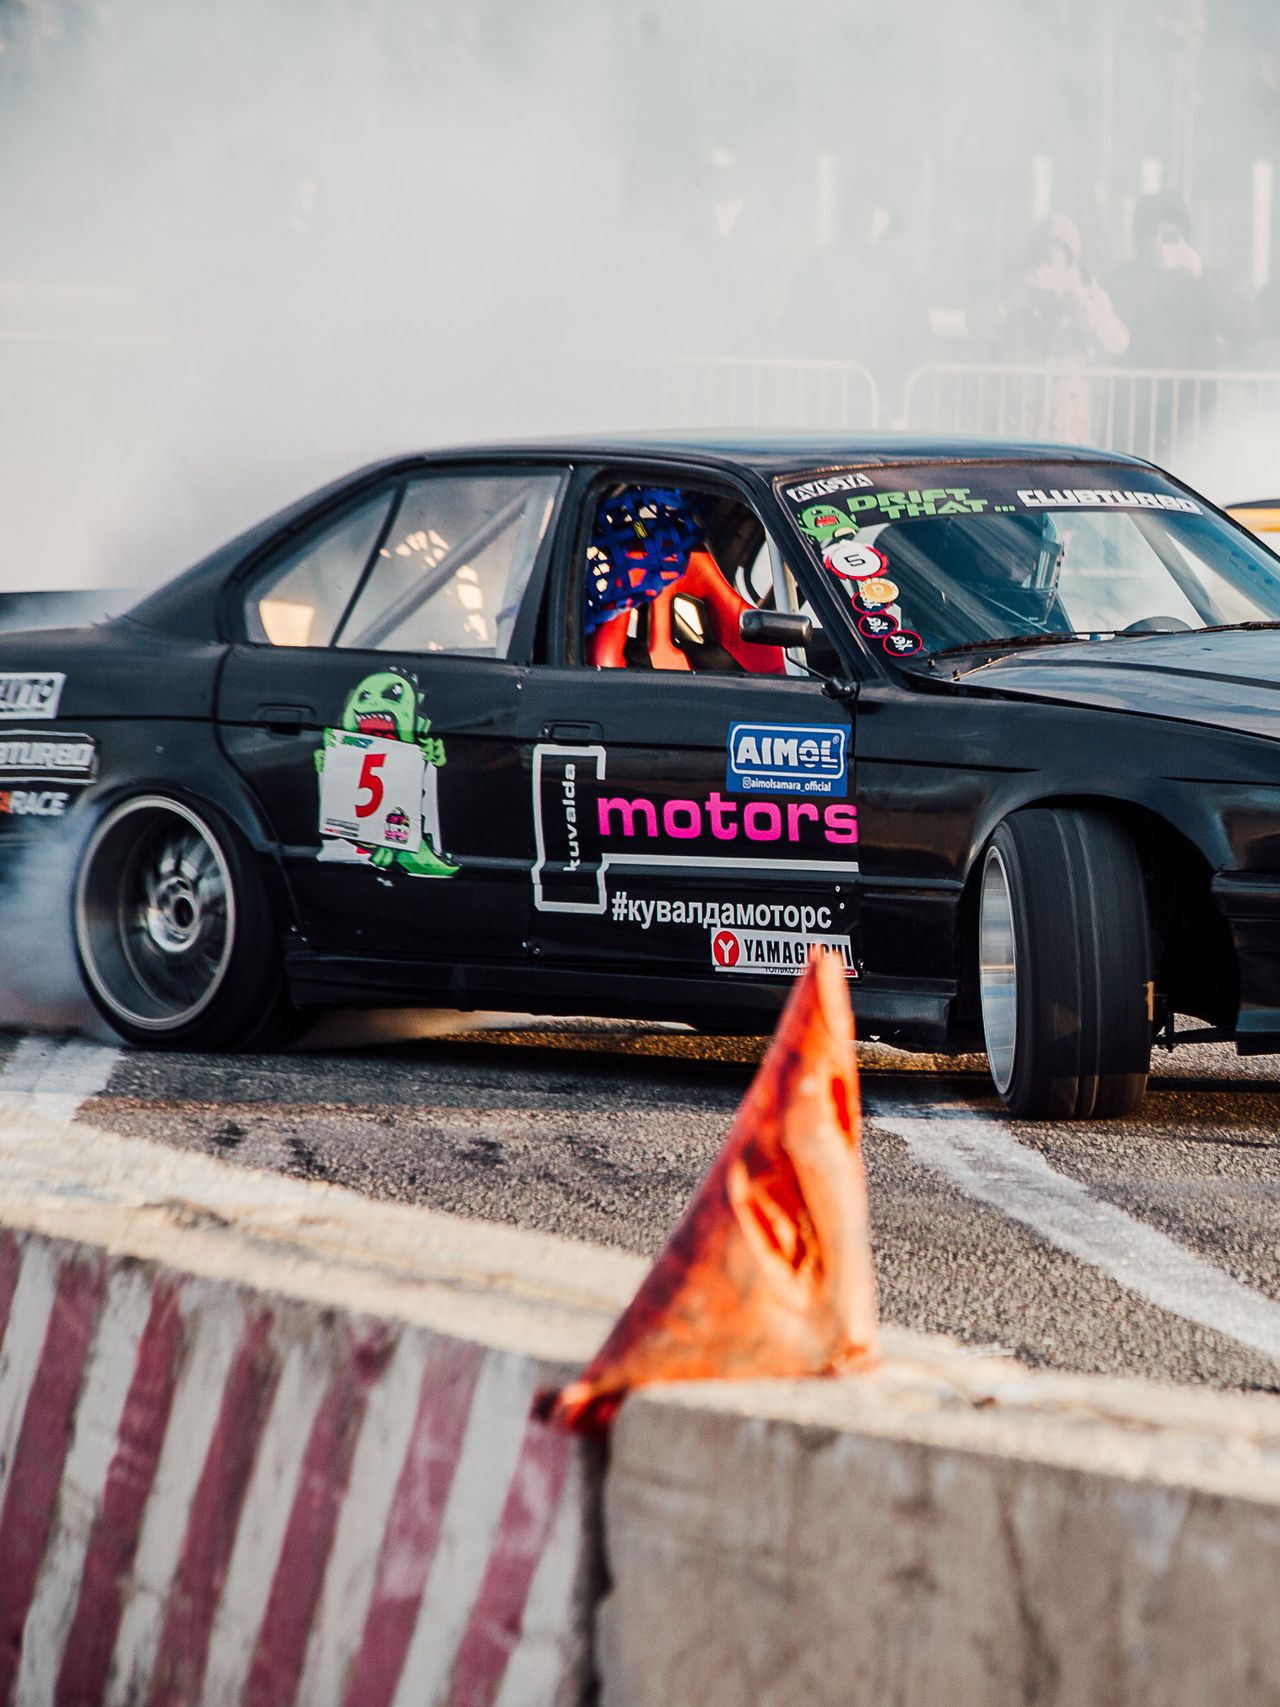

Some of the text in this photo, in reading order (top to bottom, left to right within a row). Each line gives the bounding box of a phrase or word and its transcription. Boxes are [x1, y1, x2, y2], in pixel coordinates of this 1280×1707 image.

[846, 488, 970, 513] DRIFT
[880, 499, 988, 520] THAT
[1016, 489, 1203, 516] CLUBTURBO
[844, 554, 866, 567] 5
[736, 736, 838, 769] AIMOL
[354, 753, 387, 818] 5
[561, 763, 580, 872] kuvalda
[597, 792, 859, 844] motors
[612, 891, 832, 933] #кувалдамоторс
